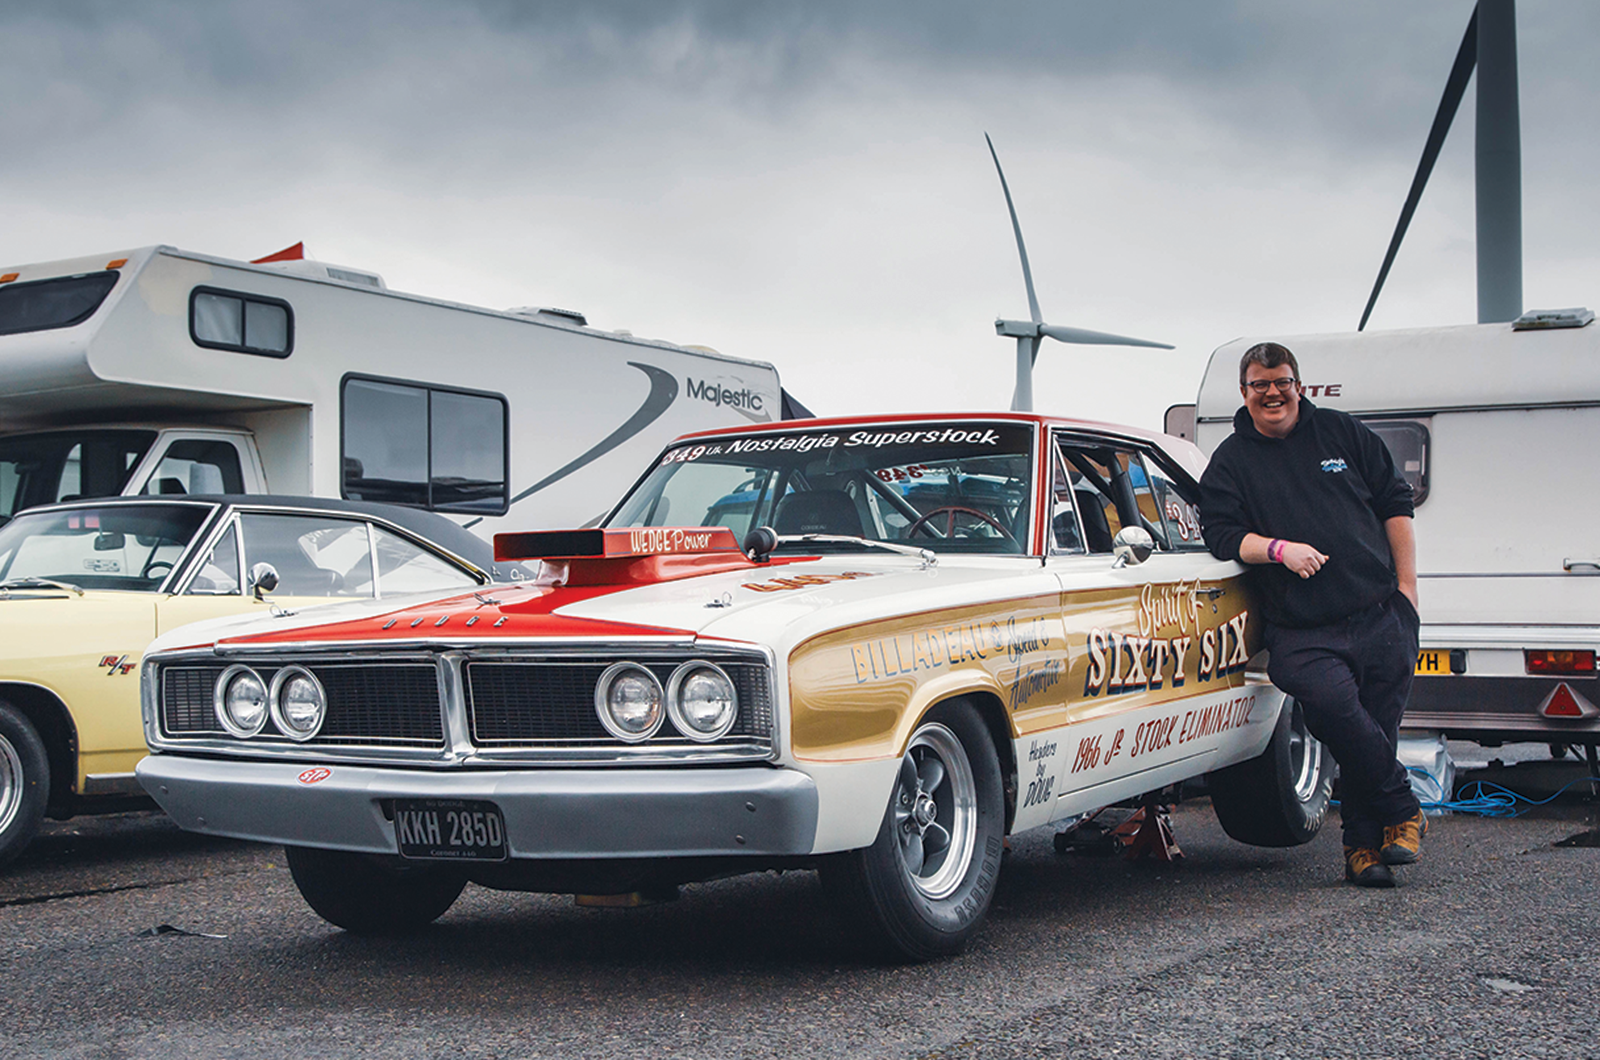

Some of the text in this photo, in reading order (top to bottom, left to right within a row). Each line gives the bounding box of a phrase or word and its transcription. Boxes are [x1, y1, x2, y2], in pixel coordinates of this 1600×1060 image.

[687, 377, 763, 410] Majestic
[1300, 384, 1342, 397] ITE
[725, 433, 840, 454] Nostalgia
[843, 428, 1000, 448] Superstock
[631, 529, 712, 553] WEDGE Power
[1138, 577, 1204, 641] Spirit of
[98, 654, 137, 676] R/T
[850, 620, 988, 684] BILLADEAU
[1083, 609, 1250, 697] SIXTY SIX
[1415, 653, 1439, 672] YH
[1071, 734, 1102, 774] 1966
[1131, 714, 1179, 758] STOCK
[1179, 695, 1256, 744] ELIMINATOR
[1028, 739, 1058, 762] Headers
[299, 769, 329, 782] STP
[1036, 760, 1046, 776] by
[1023, 776, 1055, 808] DOUG
[397, 811, 502, 847] KKH 285D
